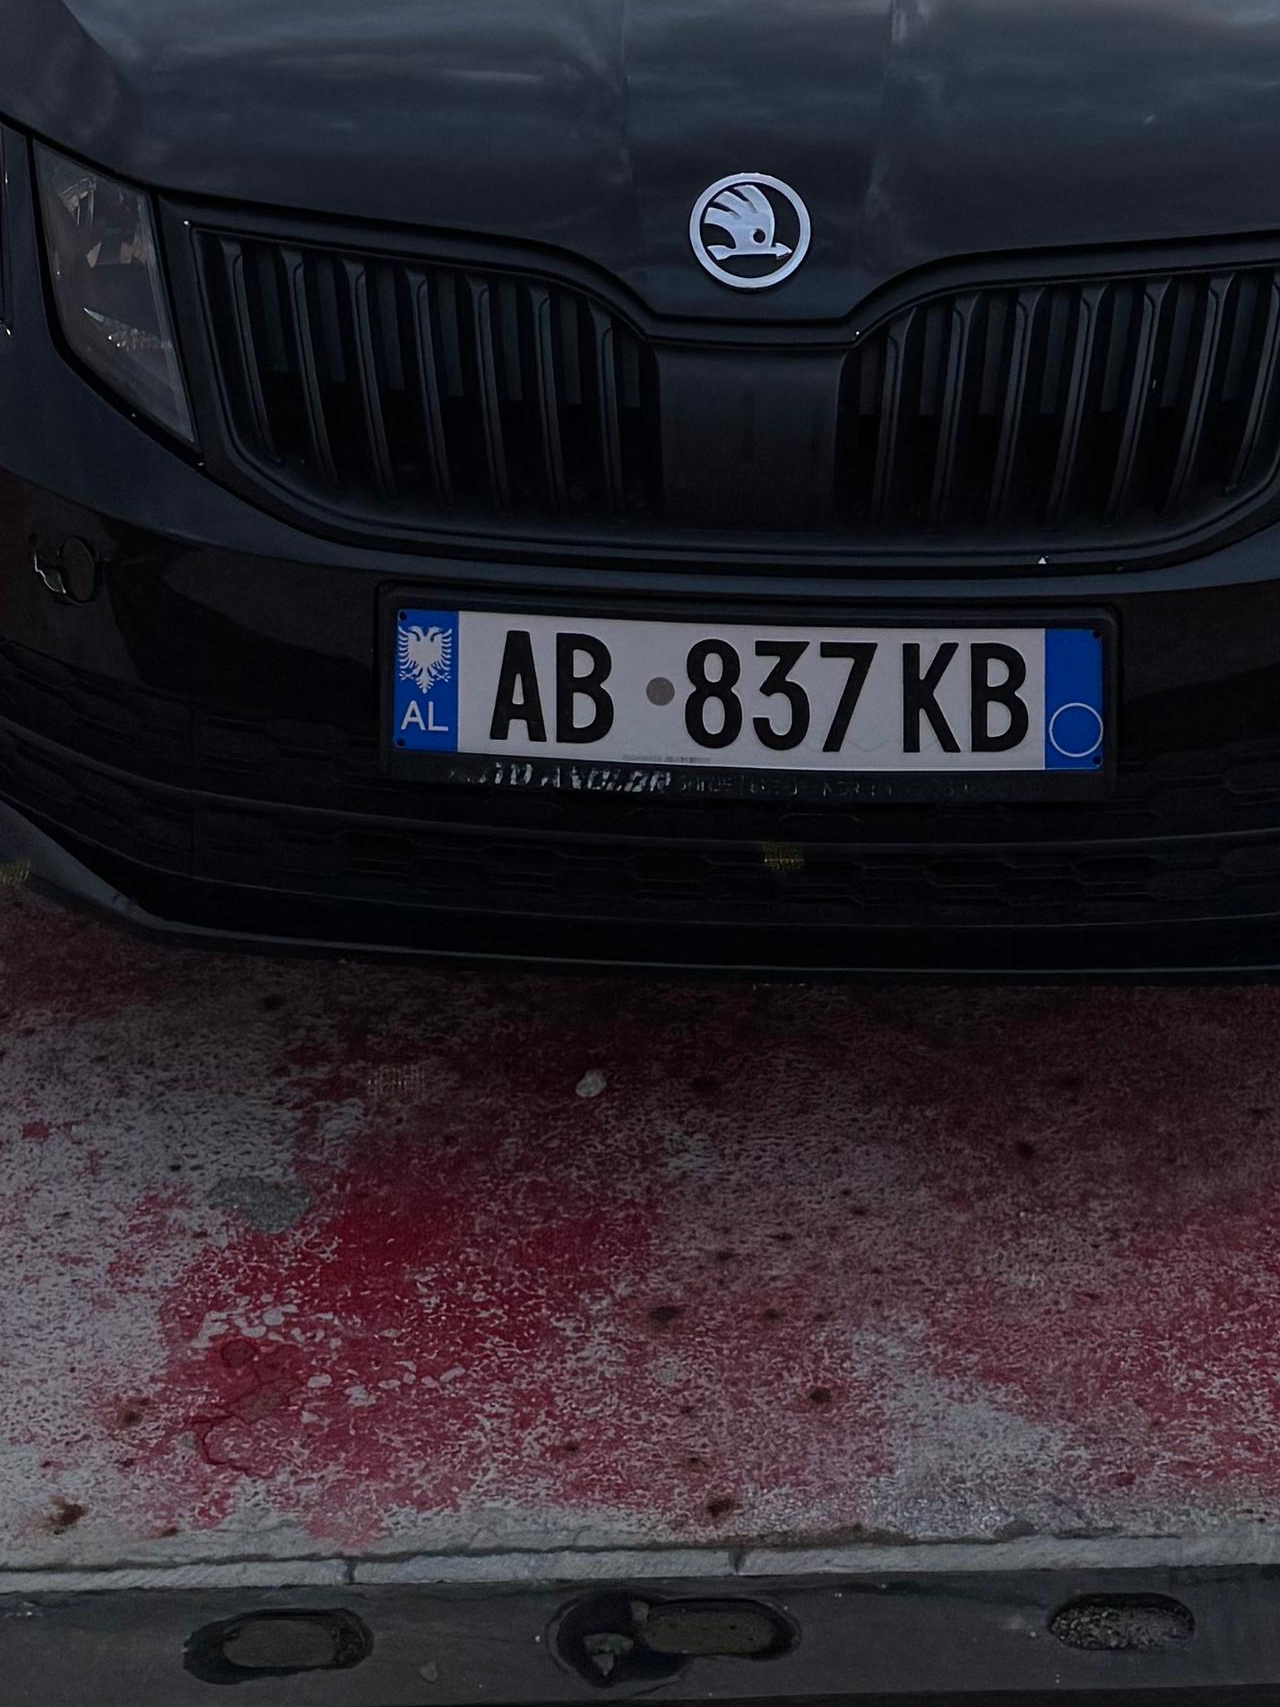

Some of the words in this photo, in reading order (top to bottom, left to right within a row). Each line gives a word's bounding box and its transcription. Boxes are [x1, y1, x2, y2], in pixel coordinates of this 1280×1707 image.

[401, 700, 449, 732] AL
[489, 630, 615, 744] AB
[684, 638, 878, 754] 837
[902, 642, 1029, 754] KB
